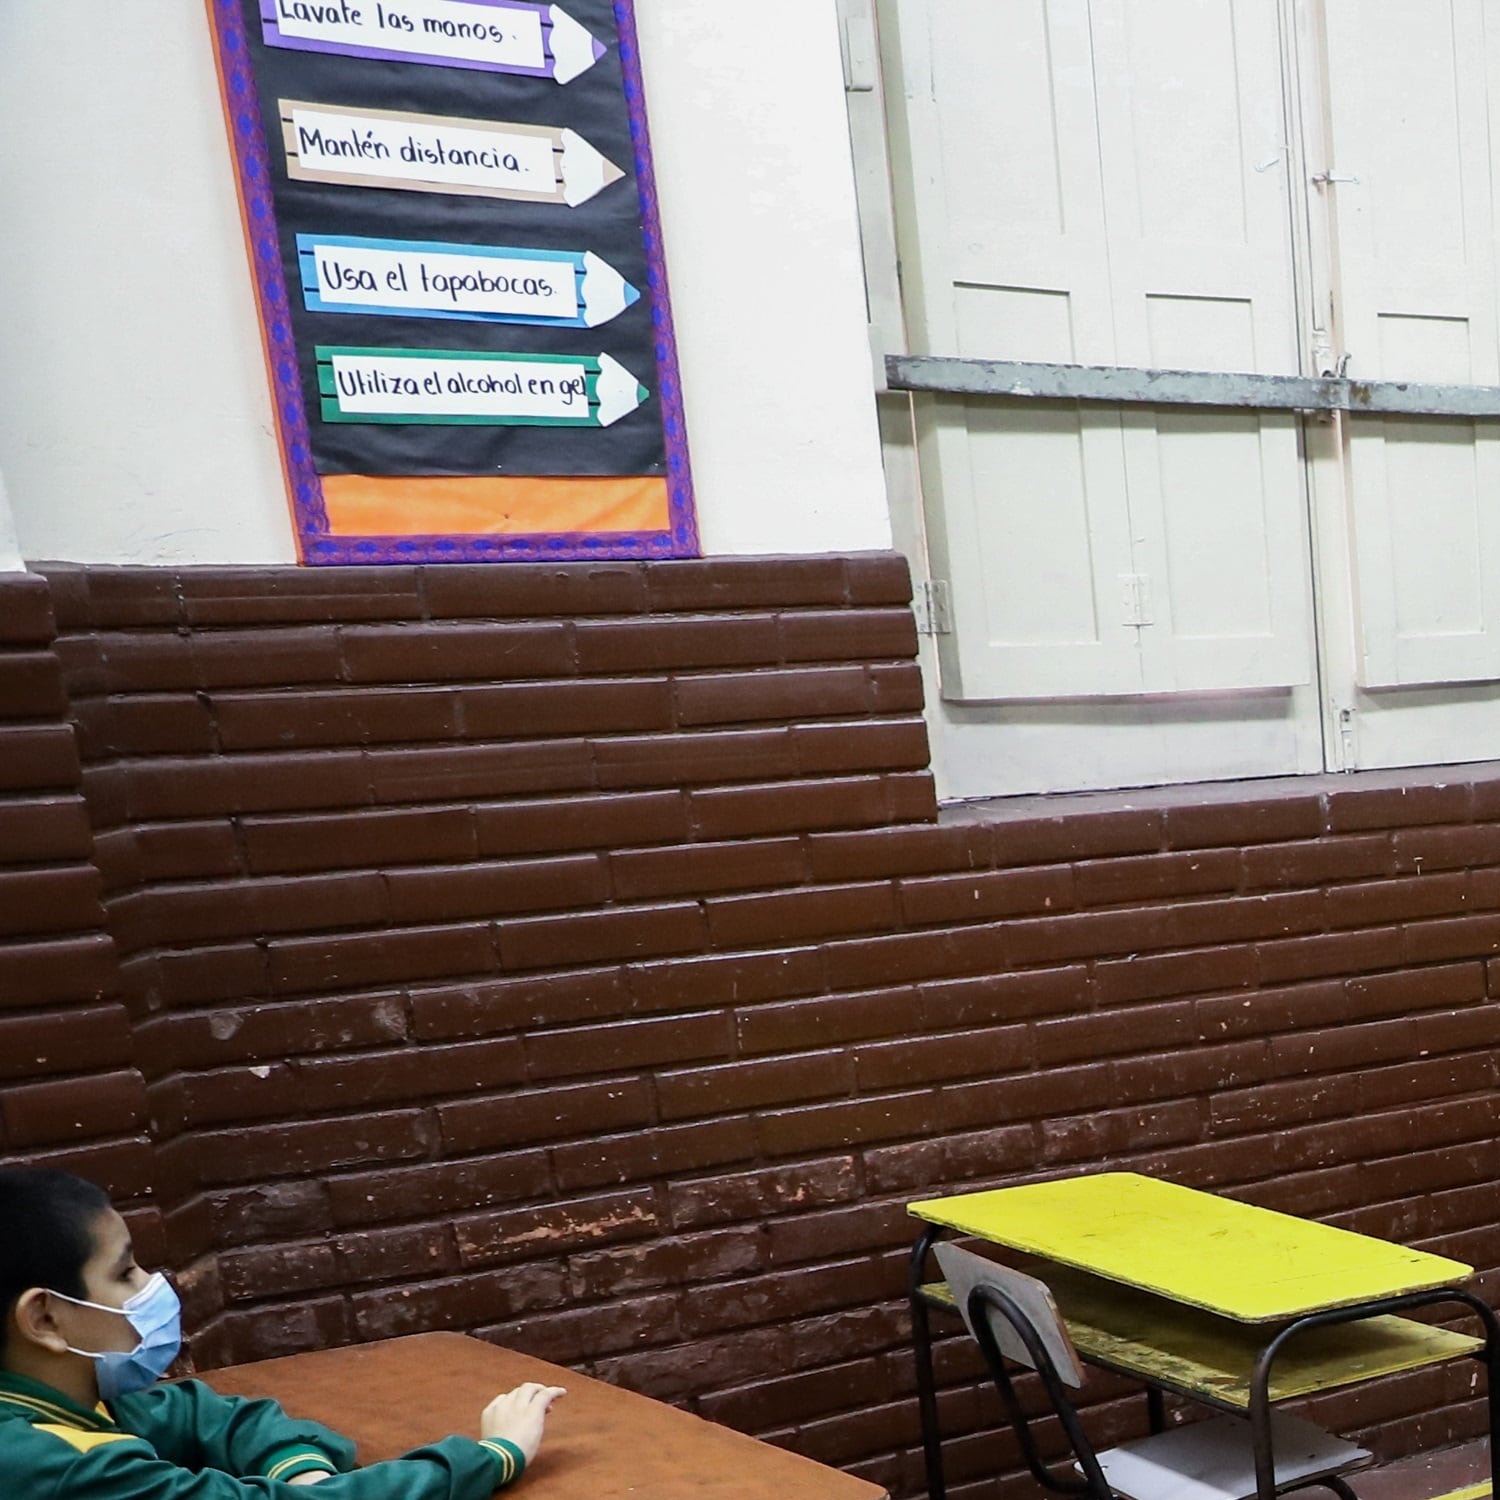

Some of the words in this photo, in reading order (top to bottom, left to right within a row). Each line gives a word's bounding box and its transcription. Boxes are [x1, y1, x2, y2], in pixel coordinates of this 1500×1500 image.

[376, 2, 414, 33] las
[298, 126, 391, 160] Mantén
[321, 260, 379, 292] Usa
[386, 262, 409, 292] el
[337, 369, 420, 397] Utiliza
[423, 371, 443, 396] el
[446, 372, 524, 395] alcohol
[528, 379, 555, 395] en
[558, 375, 587, 406] gel
